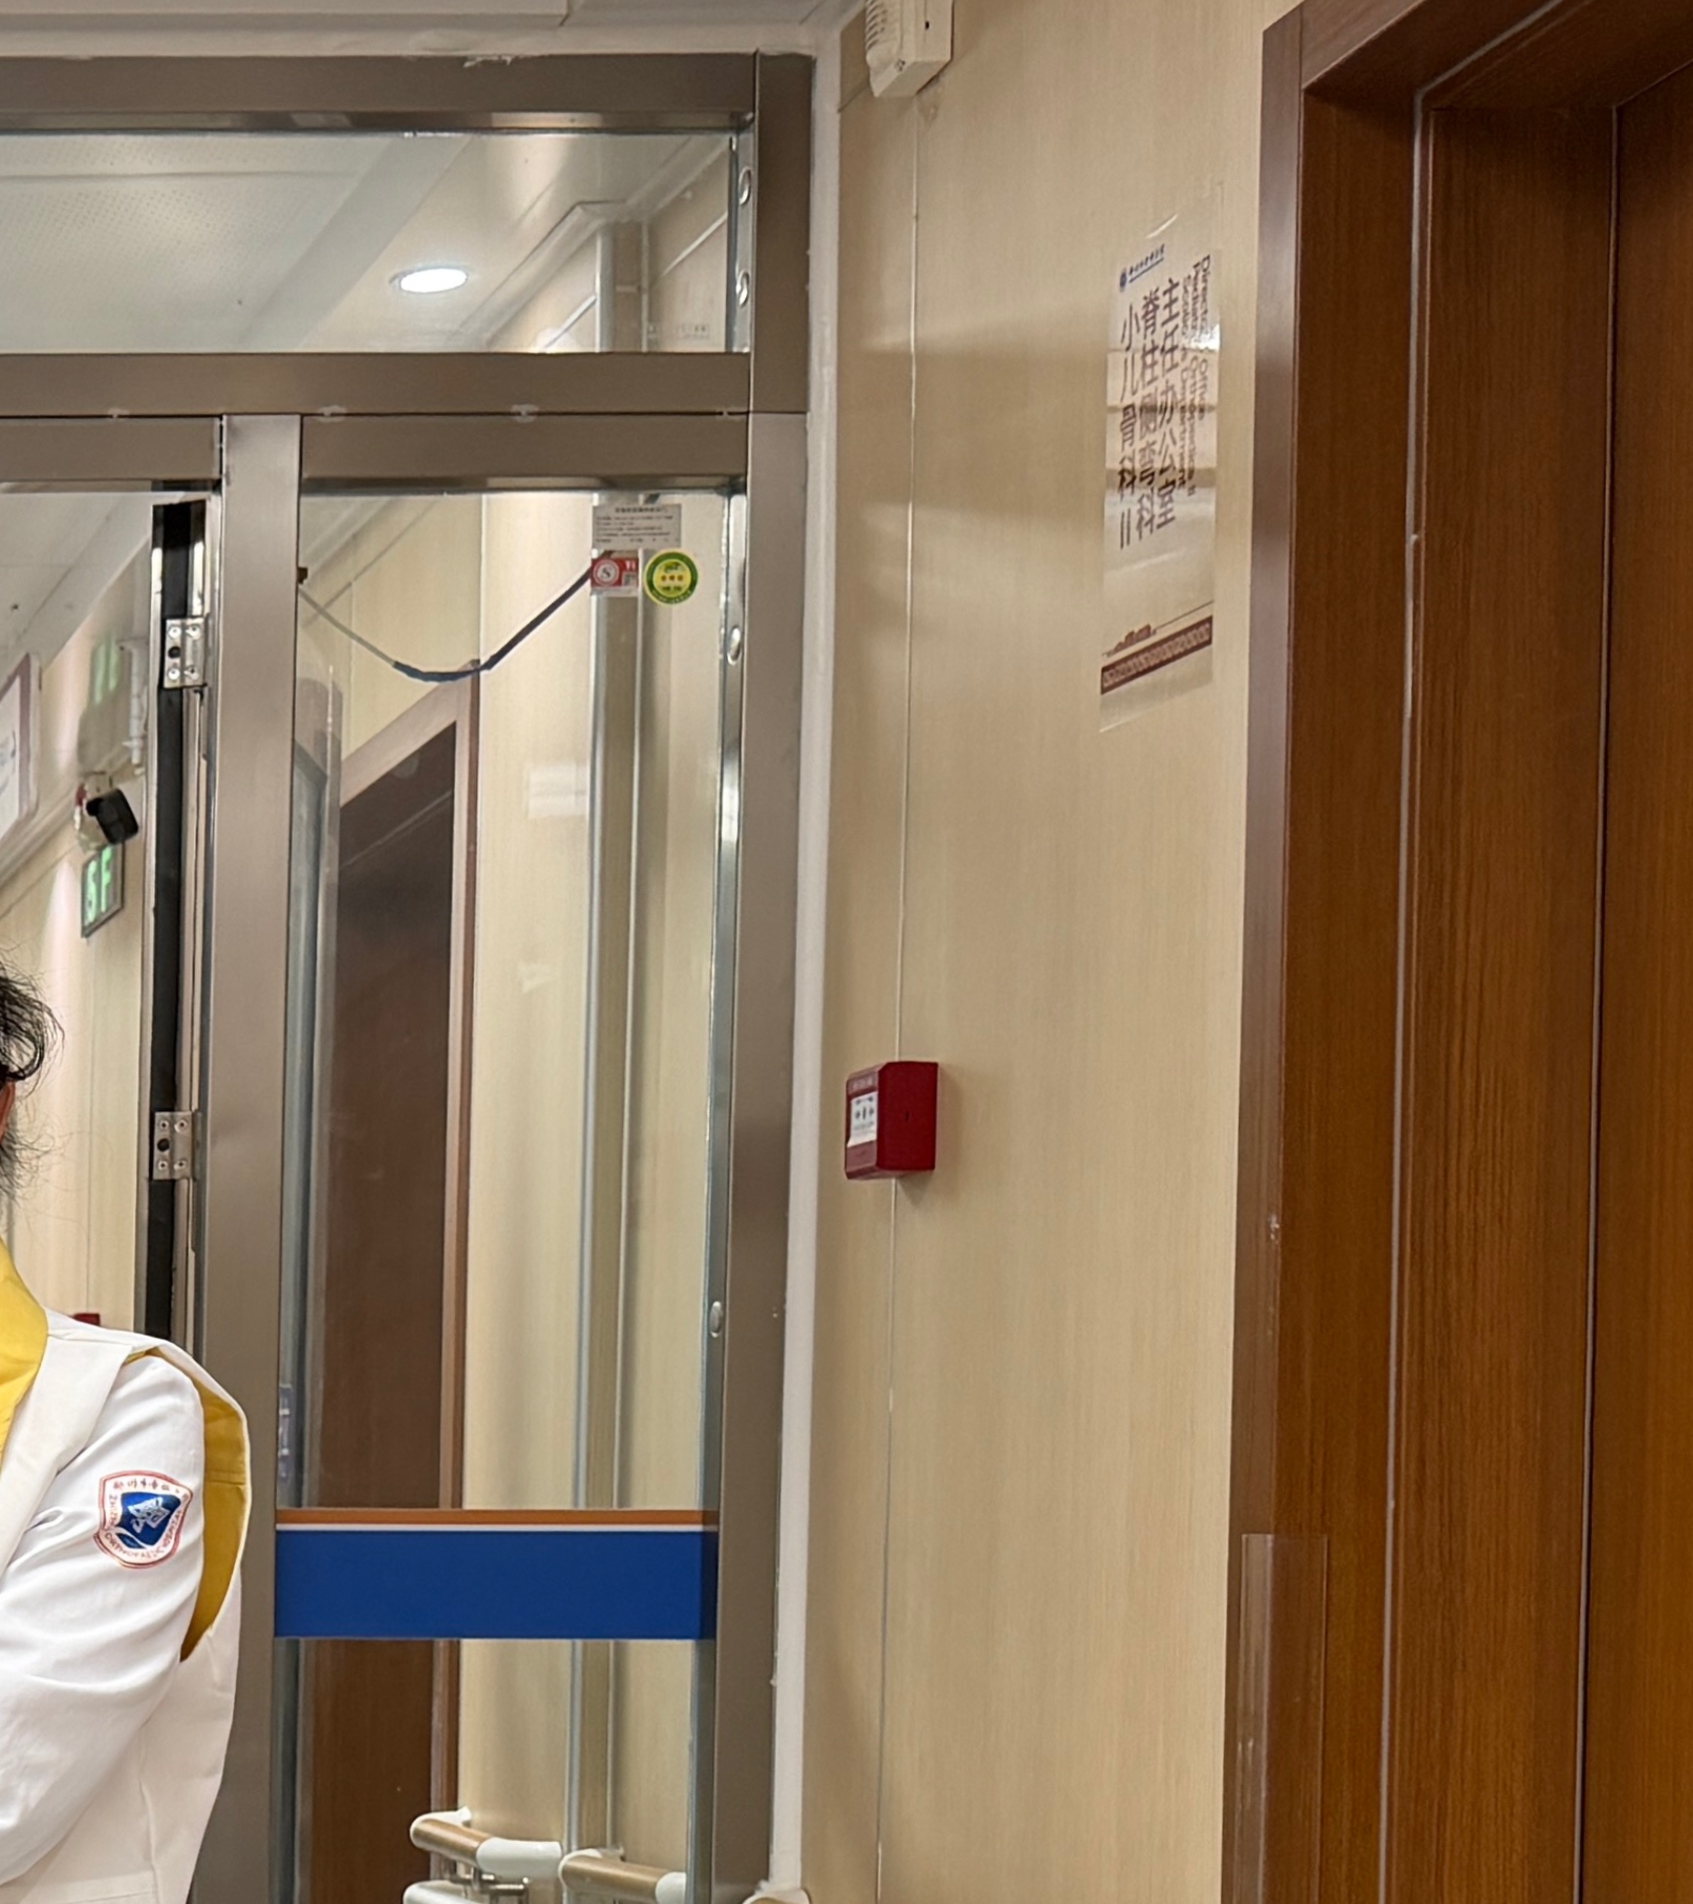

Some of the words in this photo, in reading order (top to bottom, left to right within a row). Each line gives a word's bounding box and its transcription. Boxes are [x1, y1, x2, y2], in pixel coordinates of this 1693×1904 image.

[1136, 286, 1160, 541] 脊柱侧弯科
[1157, 277, 1180, 530] 主任办公室
